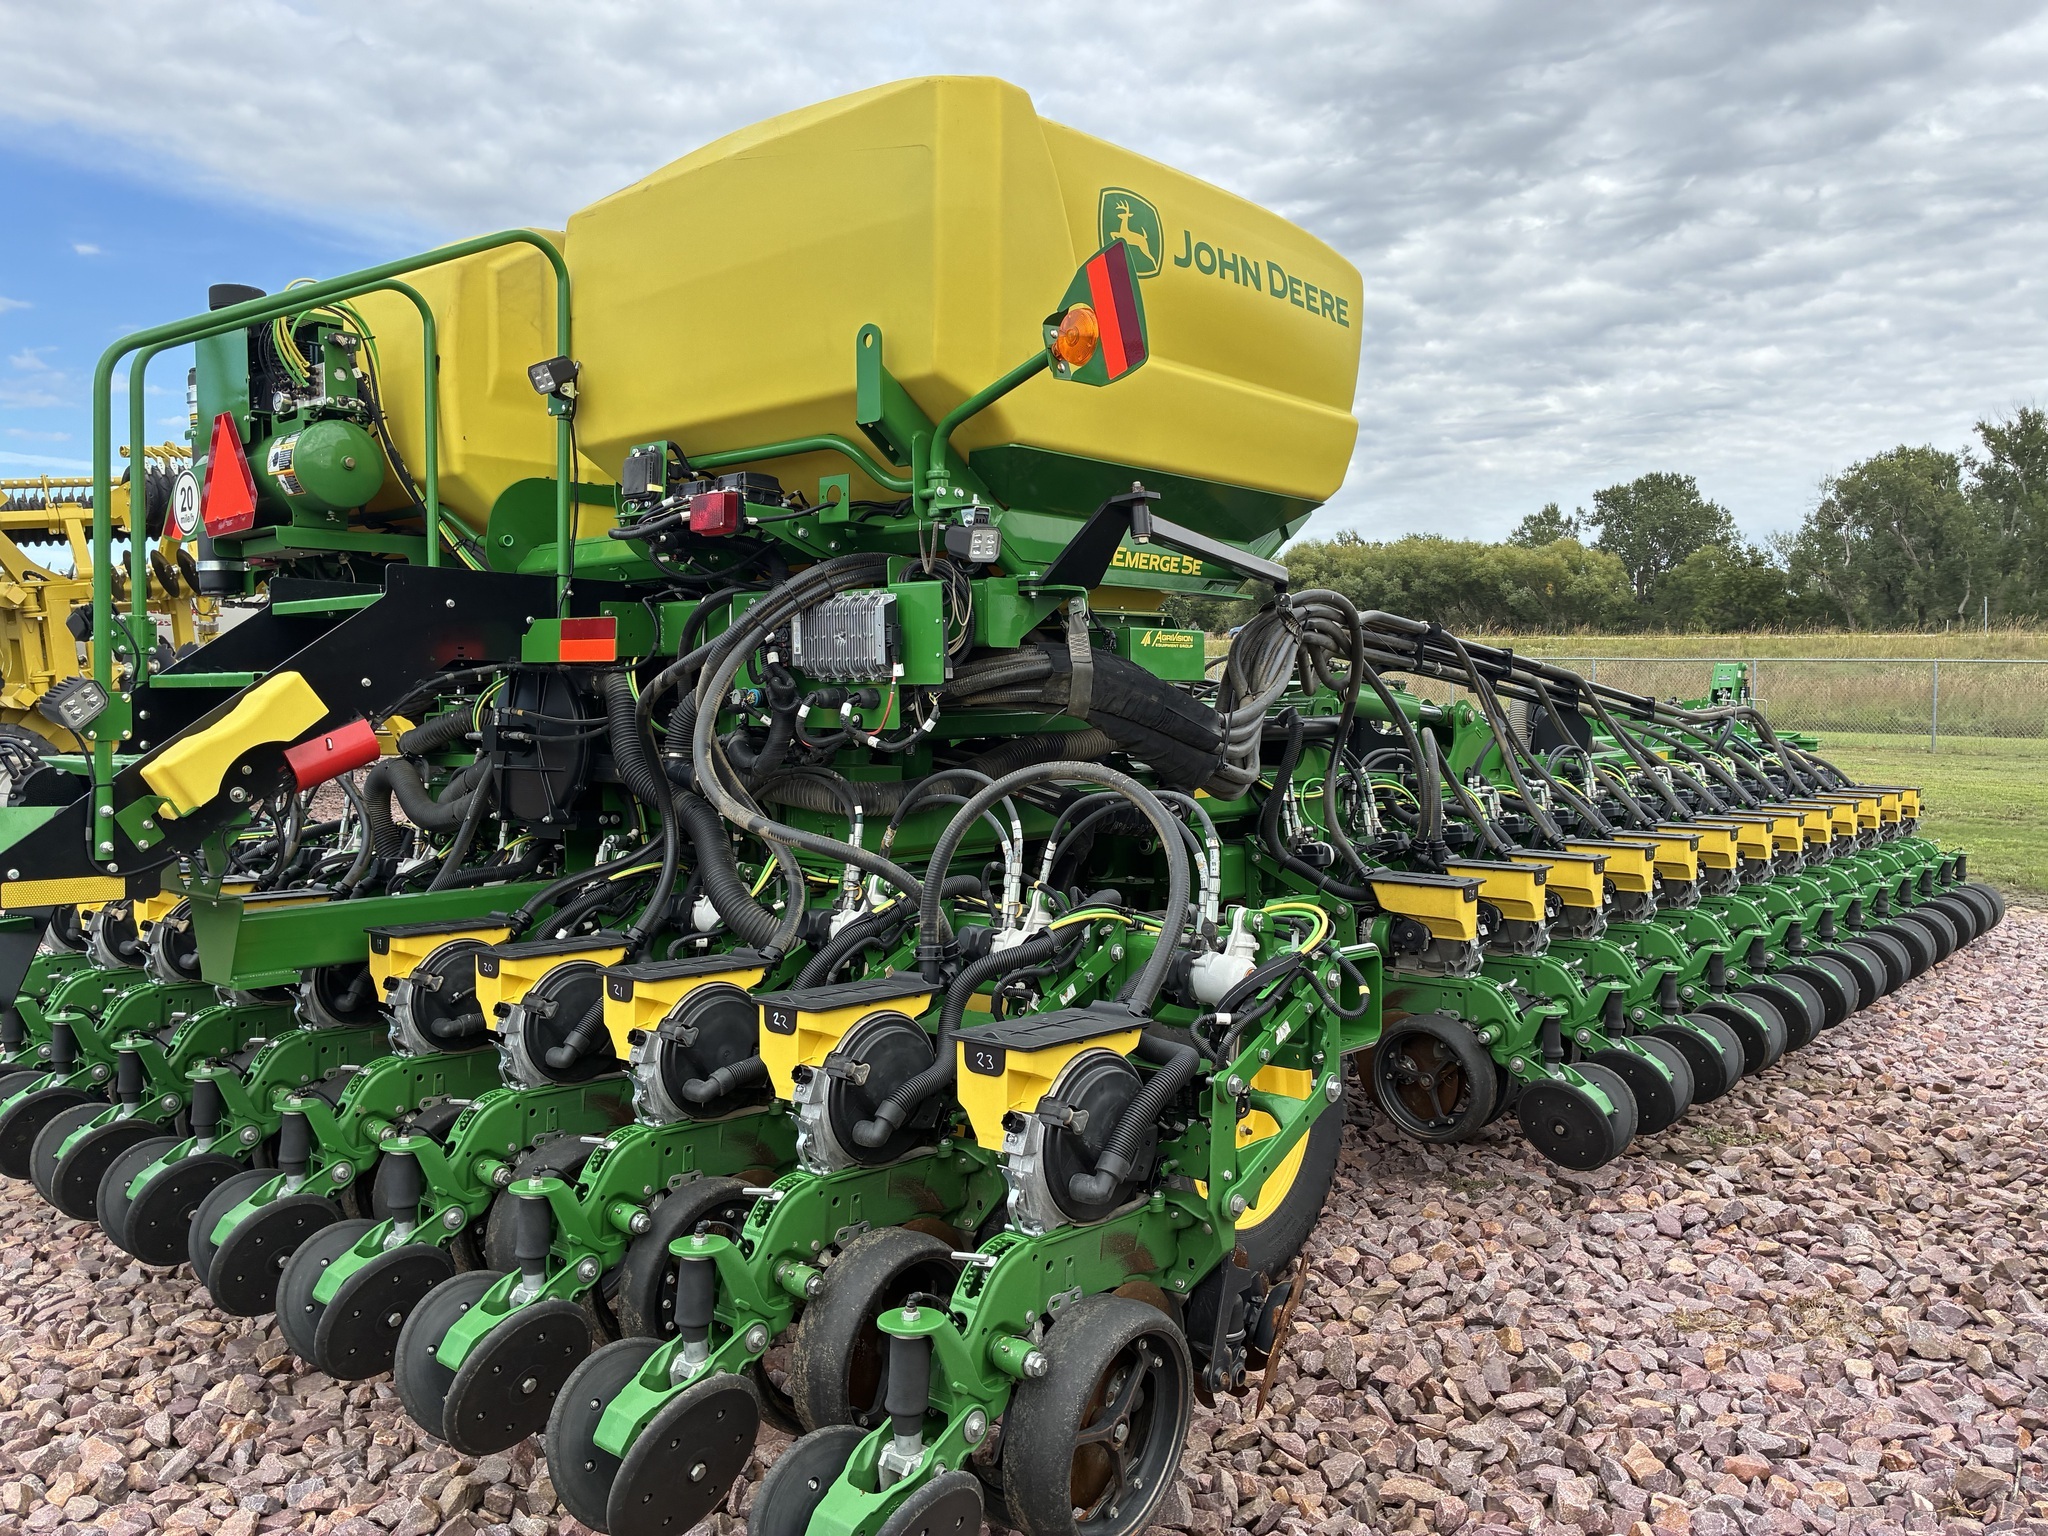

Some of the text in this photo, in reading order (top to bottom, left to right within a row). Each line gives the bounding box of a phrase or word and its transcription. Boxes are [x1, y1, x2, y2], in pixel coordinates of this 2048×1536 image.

[1174, 230, 1350, 328] JOHN DEERE
[180, 485, 193, 512] 20
[1110, 546, 1203, 576] EMERGE 5E
[483, 962, 493, 973] 20
[613, 984, 623, 998] 21
[772, 1012, 789, 1029] 22
[976, 1052, 994, 1070] 23
